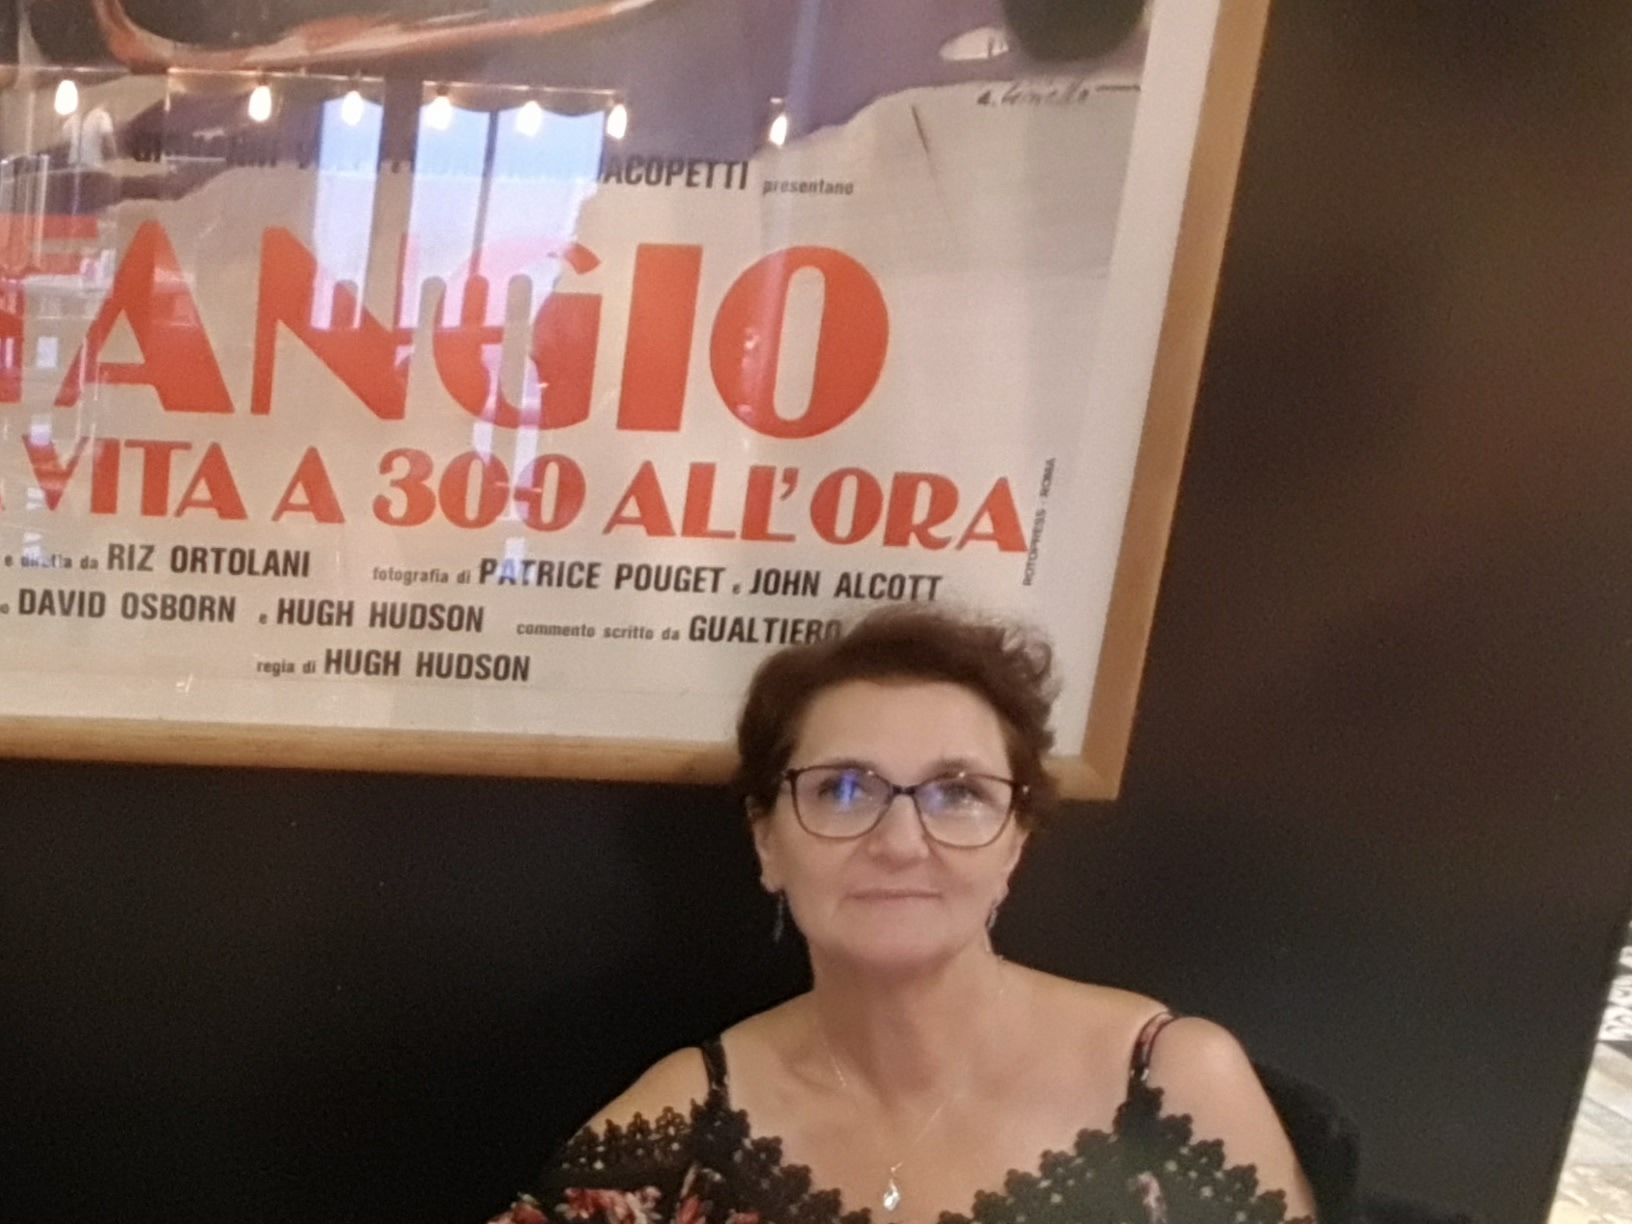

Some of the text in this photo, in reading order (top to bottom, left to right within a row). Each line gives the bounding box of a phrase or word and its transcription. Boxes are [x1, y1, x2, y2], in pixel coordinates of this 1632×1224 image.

[600, 154, 749, 190] ACOPETTI
[762, 178, 854, 196] presentano
[22, 433, 248, 520] VITA
[271, 446, 346, 524] A
[372, 448, 586, 531] 300
[4, 555, 13, 567] e
[80, 556, 99, 569] da
[106, 543, 155, 572] RIZ
[170, 545, 310, 577] ORTOLANI
[372, 567, 449, 586] fotografia
[456, 570, 471, 584] di
[478, 558, 602, 589] PATRICE
[614, 563, 726, 593] POUGET
[749, 568, 821, 597] JOHN
[833, 572, 943, 601] ALCOTT
[19, 588, 106, 618] DAVID
[121, 591, 236, 623] OSBORN
[259, 612, 268, 625] e
[276, 598, 355, 627] HUGH
[369, 601, 484, 632] HUDSON
[516, 614, 842, 645] commento scritto da GUALTIERO
[257, 648, 531, 682] regia di HUGH HUDSON
